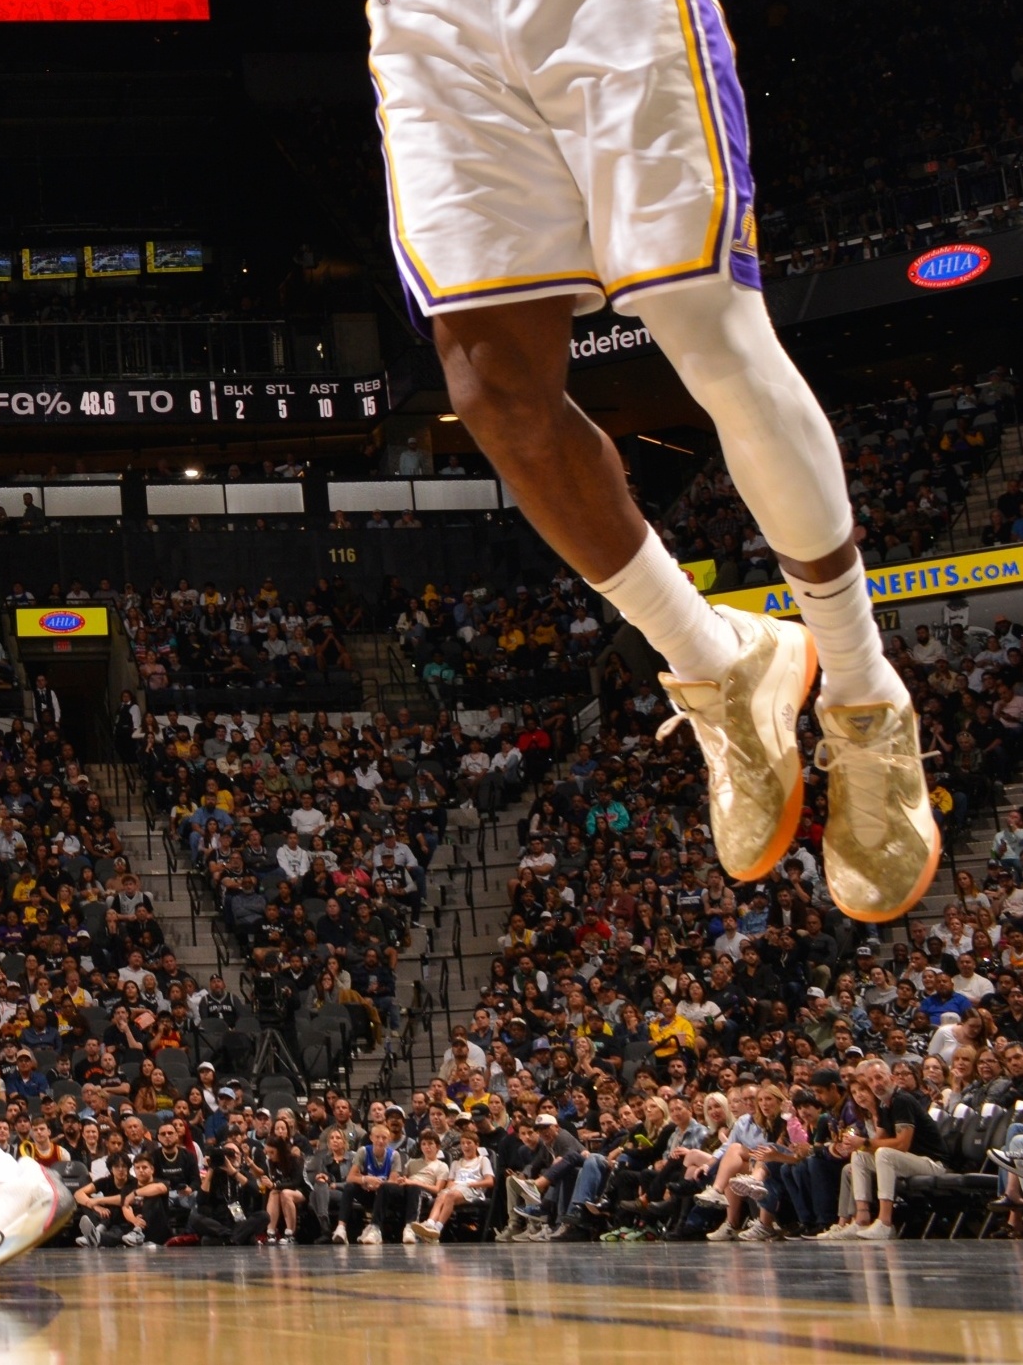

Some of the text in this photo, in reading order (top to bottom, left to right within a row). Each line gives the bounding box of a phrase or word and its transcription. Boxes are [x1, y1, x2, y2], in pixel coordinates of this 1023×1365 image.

[923, 253, 973, 279] AHIA
[224, 379, 381, 396] BLK STL AST REB
[80, 391, 116, 416] 48.6
[128, 390, 174, 413] TO
[189, 389, 202, 414] 6
[235, 396, 376, 419] 2 5 10 15
[328, 547, 356, 563] 116
[48, 618, 76, 627] AHIA
